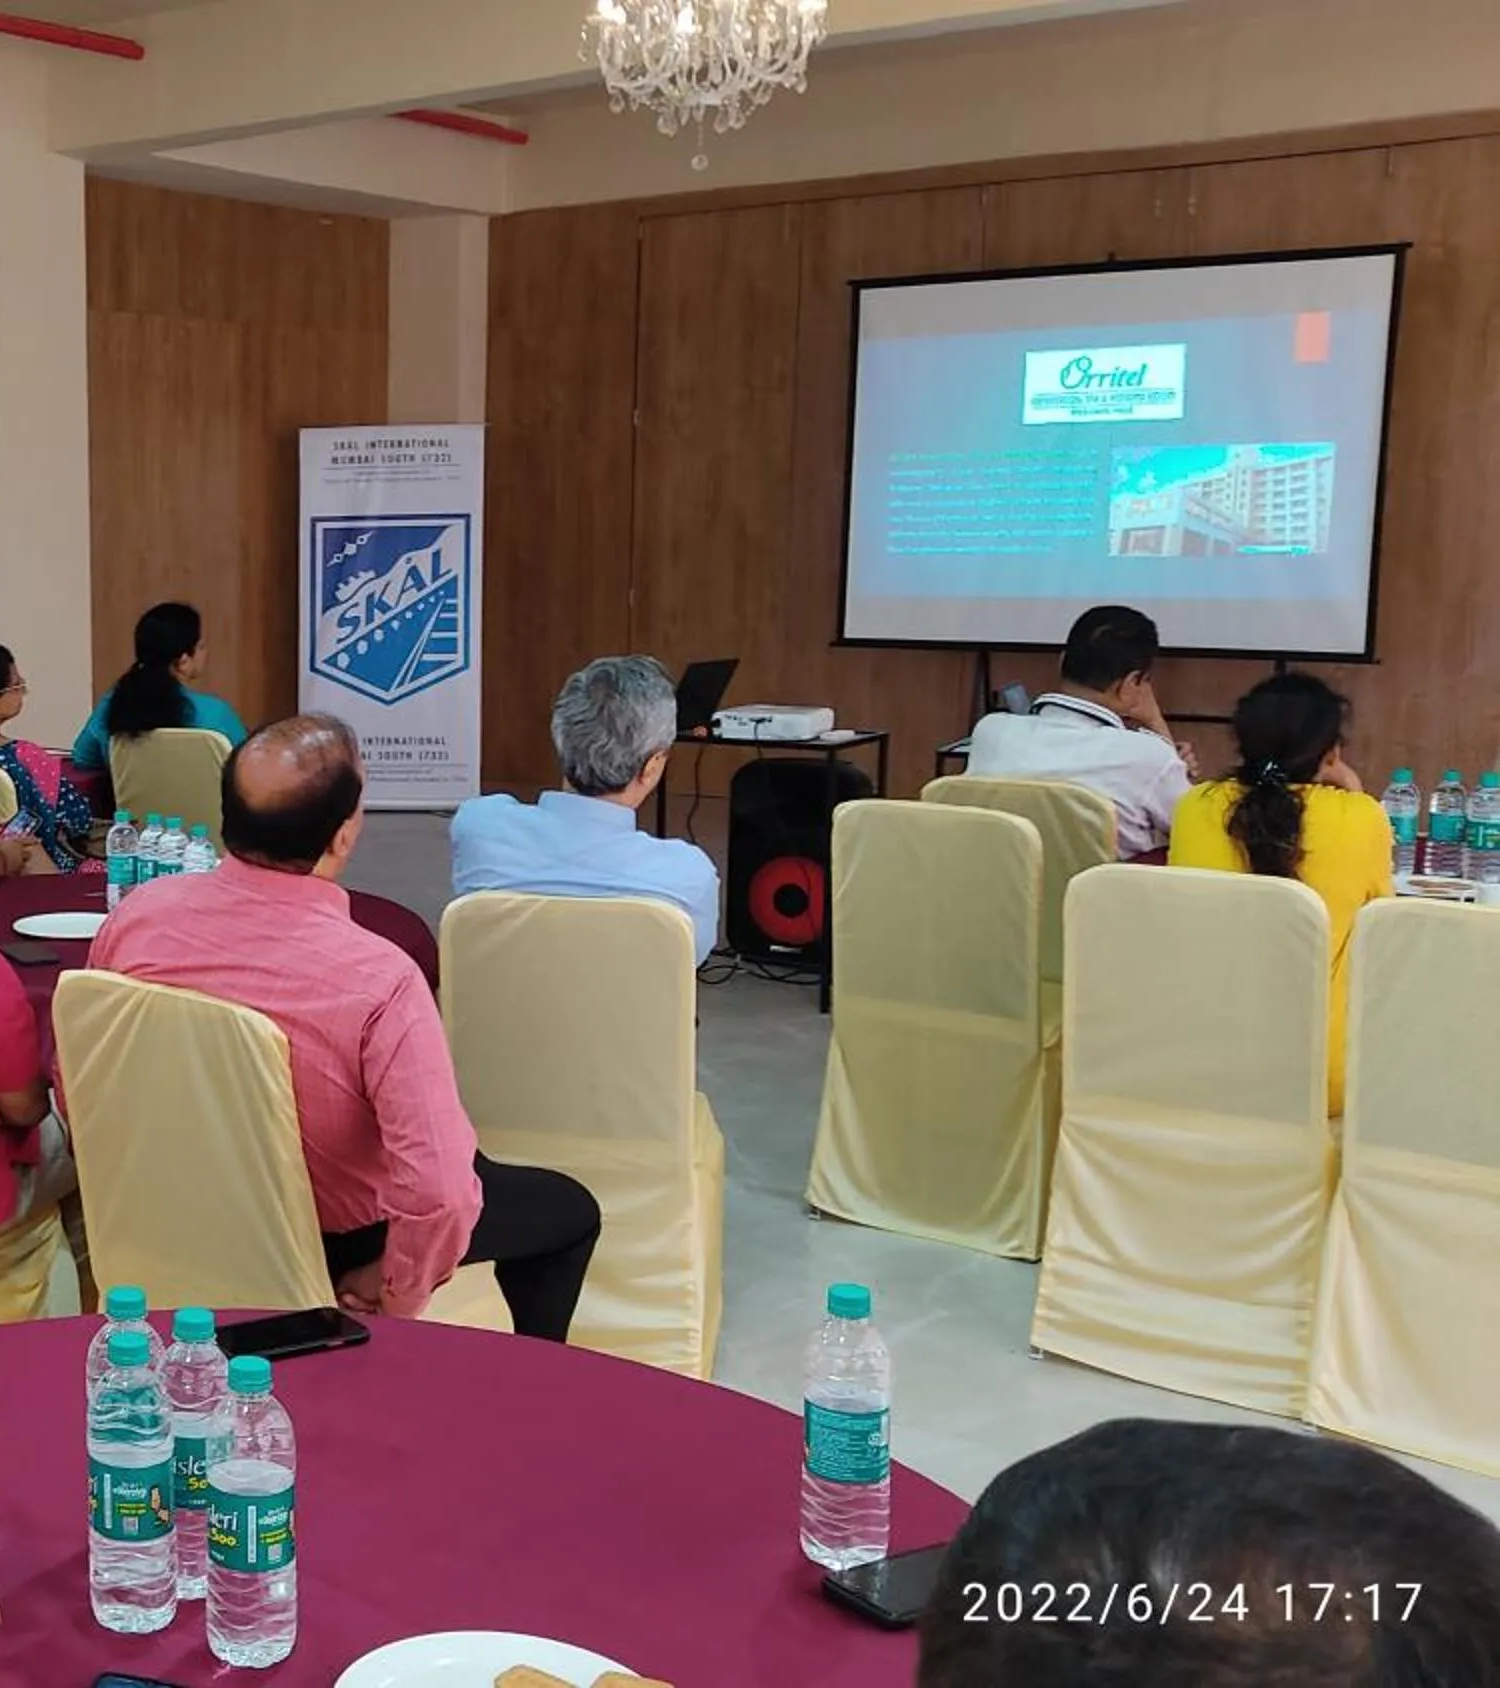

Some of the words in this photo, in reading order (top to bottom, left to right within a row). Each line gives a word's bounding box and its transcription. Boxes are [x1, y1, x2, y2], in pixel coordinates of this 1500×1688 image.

[1060, 356, 1148, 389] Orritel
[365, 437, 450, 450] INTERNATIONAL
[331, 454, 375, 465] MUMBAI
[381, 453, 415, 465] SOUTH
[362, 736, 446, 746] INTERNATIONAL
[378, 751, 413, 761] SOUTH
[172, 1455, 207, 1476] isle
[188, 1477, 209, 1490] 50
